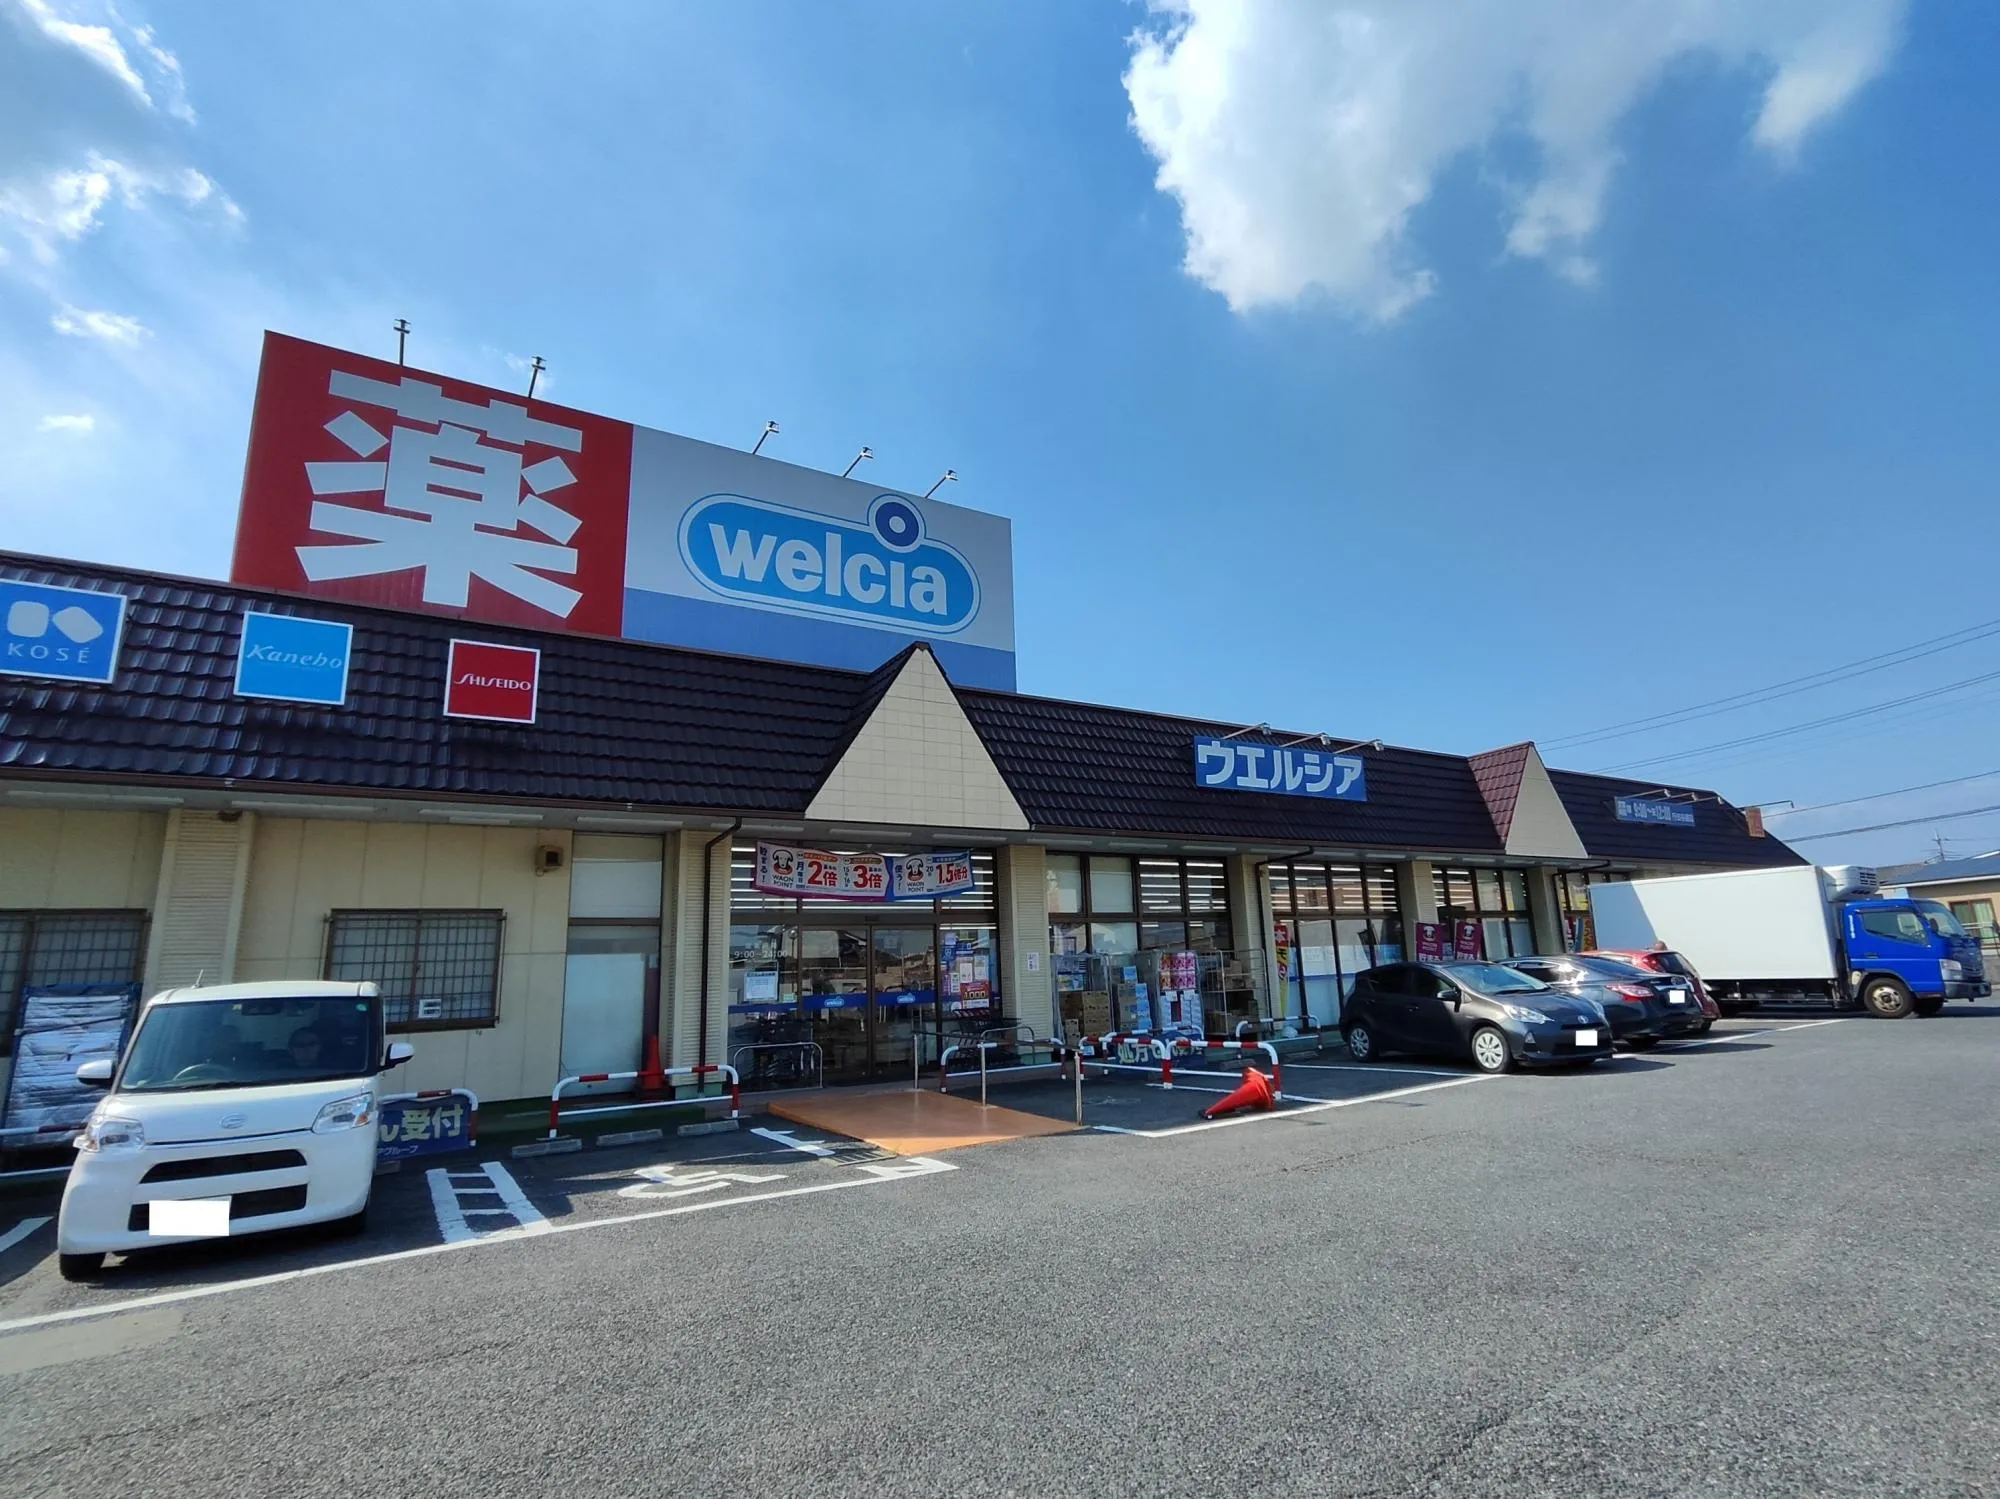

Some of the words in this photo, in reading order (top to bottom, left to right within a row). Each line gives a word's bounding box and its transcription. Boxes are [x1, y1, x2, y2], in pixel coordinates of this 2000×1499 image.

[295, 369, 583, 618] 薬
[708, 500, 948, 616] welcia
[8, 642, 92, 664] KOSÉ
[246, 643, 343, 669] Kanebo
[453, 673, 532, 691] SHISEIDO
[1197, 740, 1362, 795] ウエルシア
